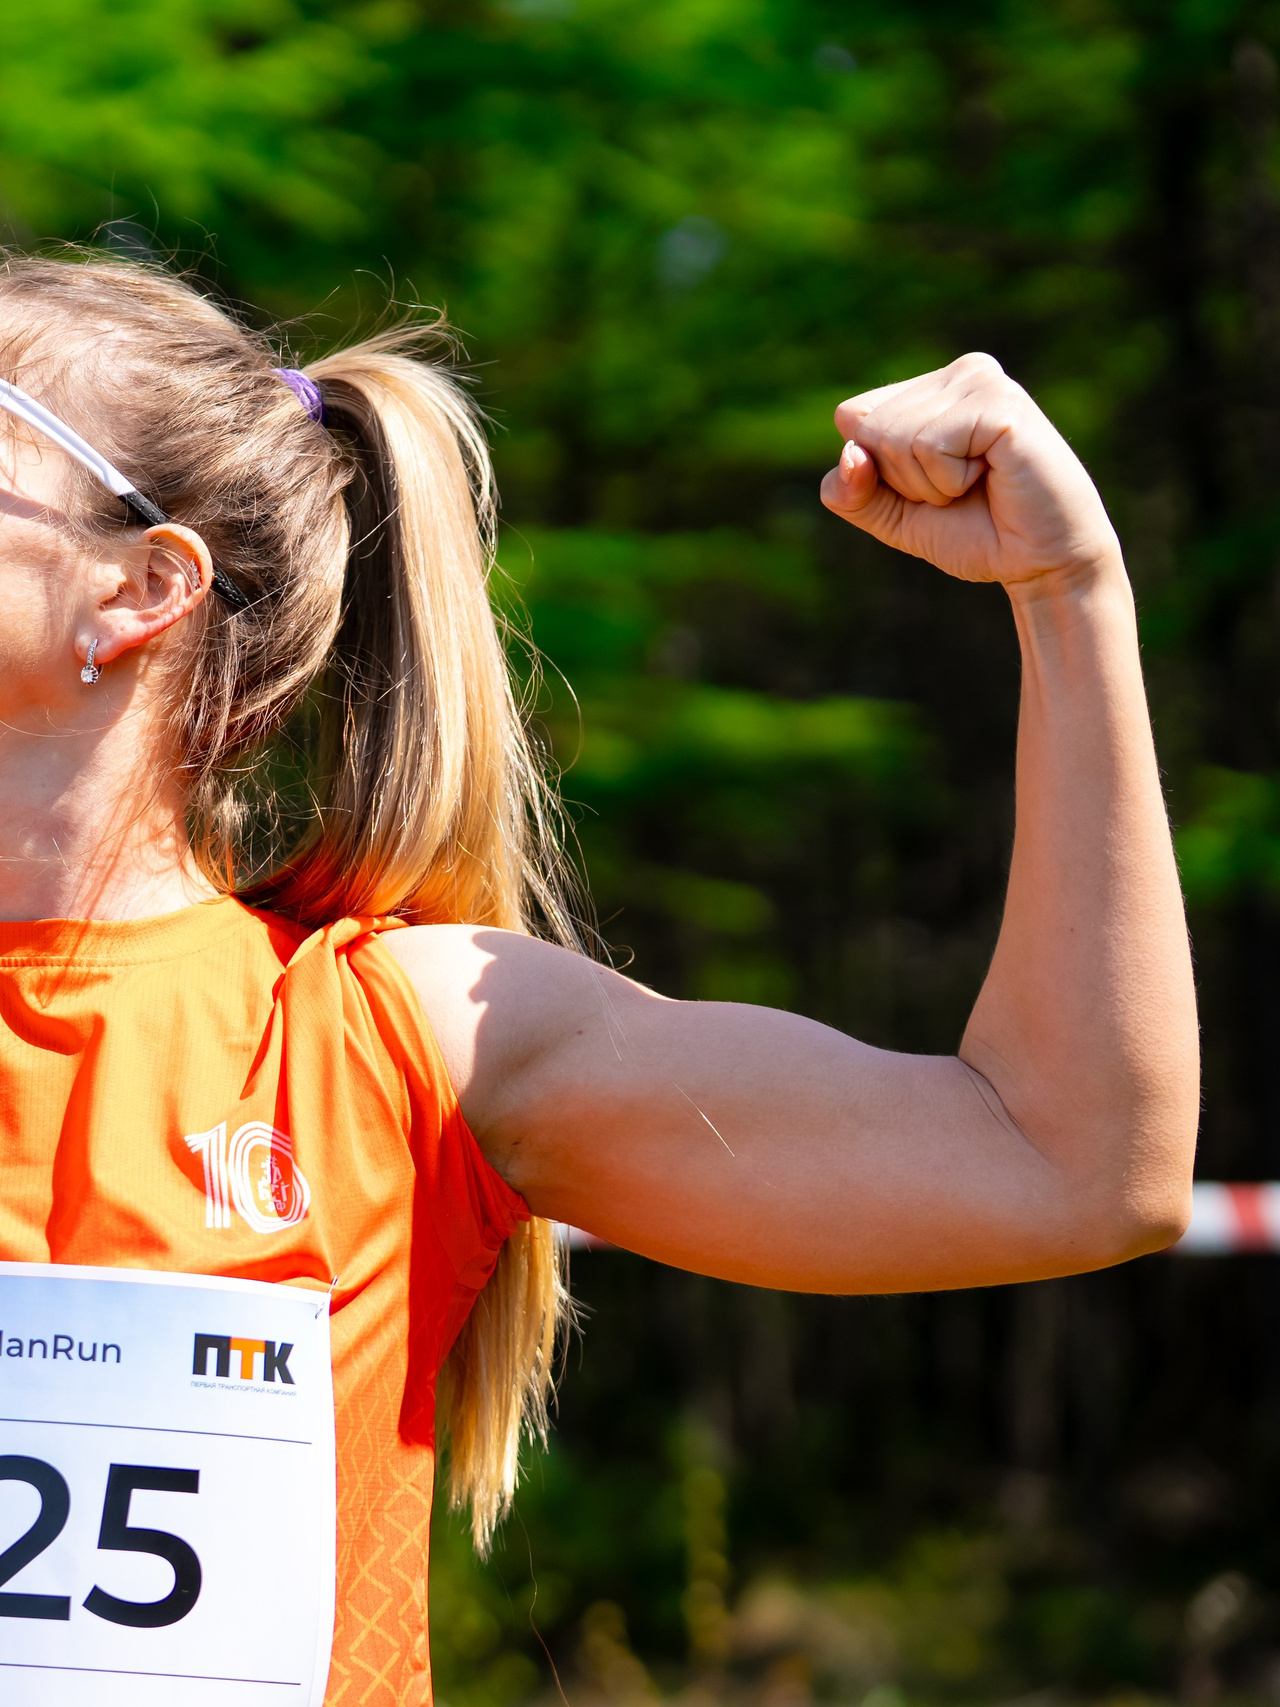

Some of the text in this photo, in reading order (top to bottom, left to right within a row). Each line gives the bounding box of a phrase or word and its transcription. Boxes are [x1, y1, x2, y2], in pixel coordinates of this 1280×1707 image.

[184, 1120, 311, 1234] 10
[192, 1332, 295, 1385] ПТК
[191, 1381, 217, 1389] ПЕРВАЯ
[218, 1383, 266, 1394] ТРАНСПОРТНАЯ
